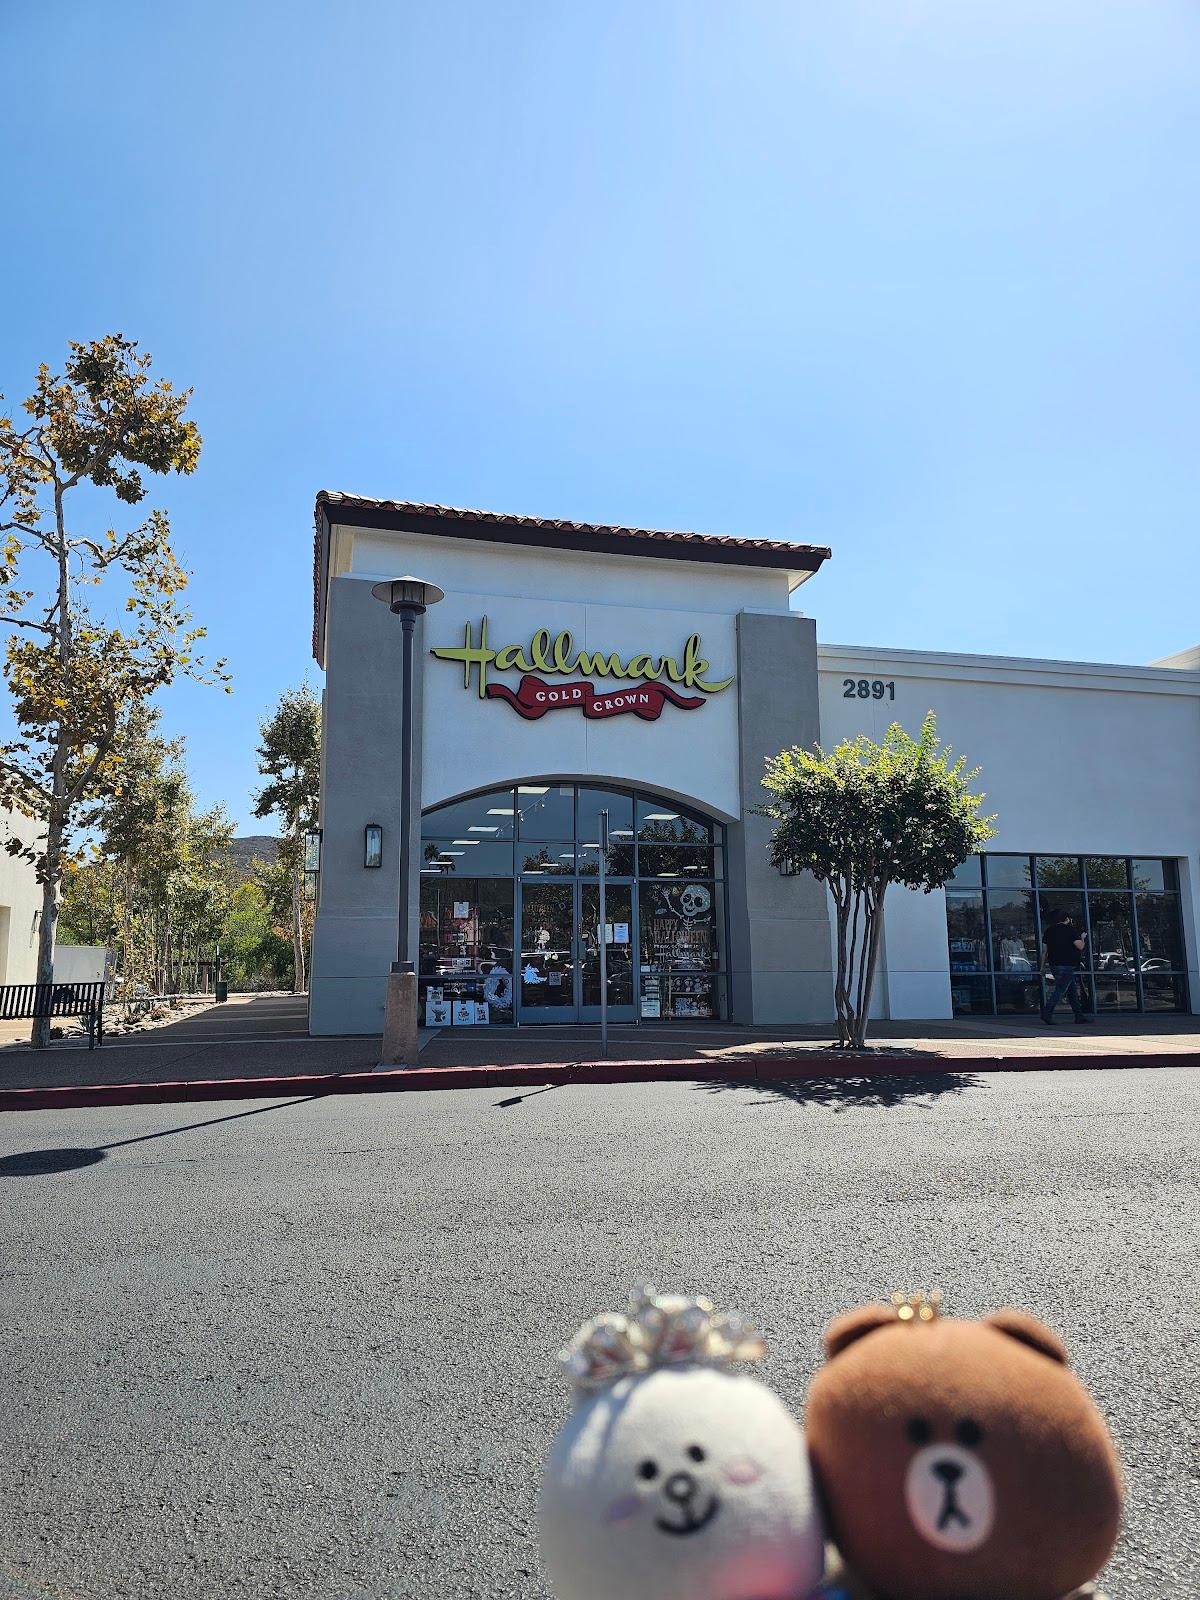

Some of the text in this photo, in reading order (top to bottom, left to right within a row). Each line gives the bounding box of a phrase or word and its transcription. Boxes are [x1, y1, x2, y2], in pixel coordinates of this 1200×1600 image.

[430, 614, 736, 699] Hallmark
[843, 679, 895, 701] 2891
[535, 689, 649, 712] GOLD CROWN
[653, 918, 679, 931] HAPPY
[653, 930, 709, 944] HALLOWEEN
[654, 948, 711, 963] Hallmark
